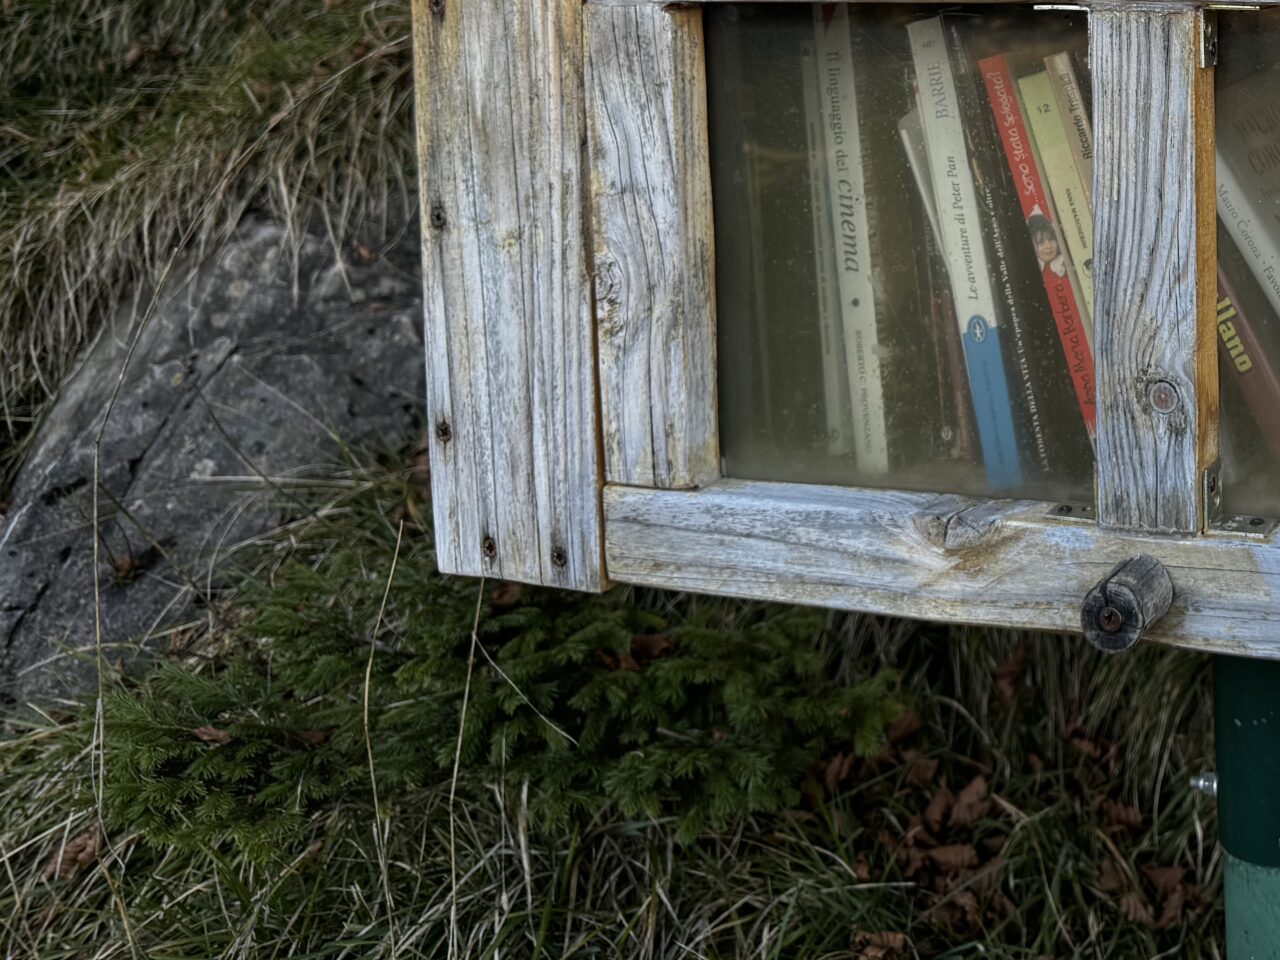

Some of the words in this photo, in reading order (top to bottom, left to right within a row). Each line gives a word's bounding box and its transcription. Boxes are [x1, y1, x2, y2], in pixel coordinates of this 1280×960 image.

[825, 50, 839, 62] Il
[826, 66, 845, 145] linguaggio
[926, 60, 950, 119] BARRIE
[1072, 112, 1094, 160] Riccardo
[835, 148, 849, 172] del
[947, 155, 957, 178] Pan
[950, 180, 963, 211] Peter
[837, 178, 860, 273] cinema
[954, 211, 966, 226] di
[1217, 183, 1240, 220] Mauro
[1235, 218, 1262, 259] Corona
[959, 226, 976, 285] avventure
[968, 285, 979, 300] Le
[1069, 335, 1086, 373] Maria
[1216, 296, 1253, 373] llano
